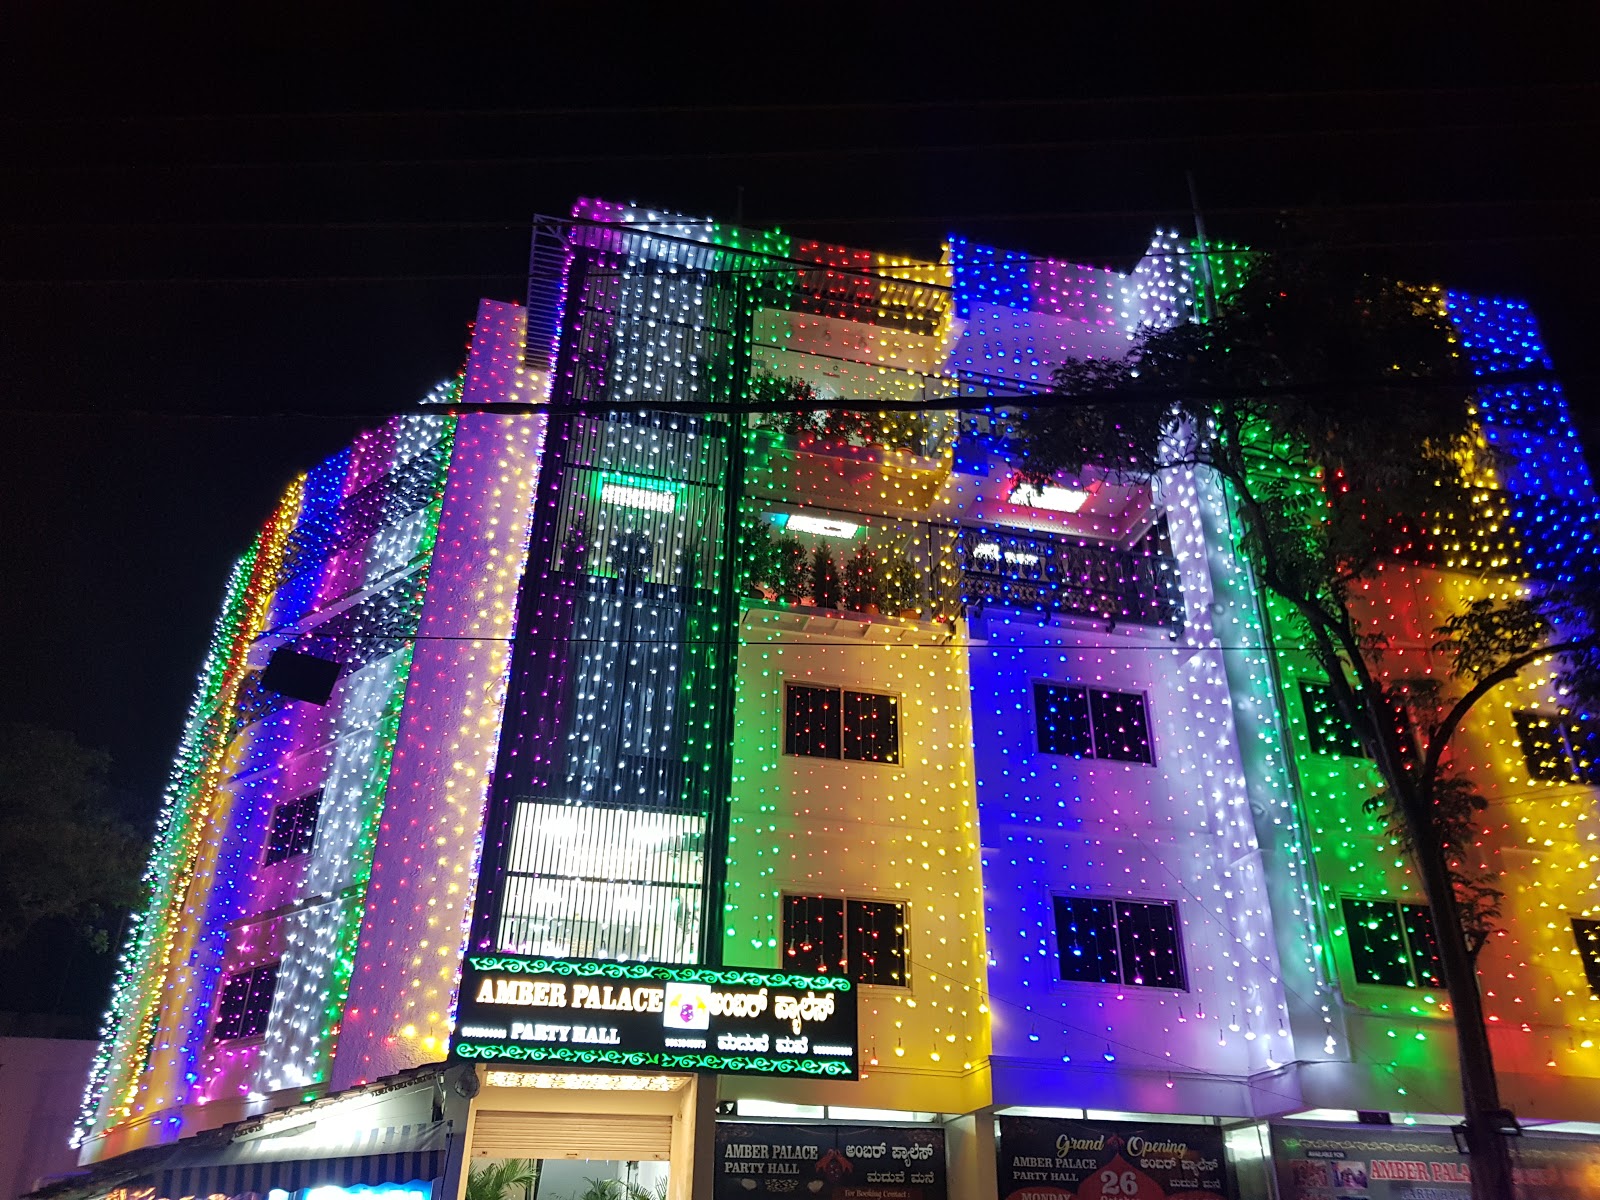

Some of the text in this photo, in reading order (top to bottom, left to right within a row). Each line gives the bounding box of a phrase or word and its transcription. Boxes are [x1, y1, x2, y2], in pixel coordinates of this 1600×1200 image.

[476, 978, 664, 1013] AMBER PALACE
[511, 1023, 571, 1043] PARTY
[572, 1026, 621, 1045] HALL
[724, 1143, 818, 1160] AMBER PALACE
[1055, 1134, 1187, 1159] Grand Opening
[724, 1162, 799, 1175] PARTY HALL
[1013, 1156, 1097, 1170] AMBER PALACE
[1370, 1159, 1471, 1184] AMBER PALA
[1013, 1171, 1079, 1182] PARTY HALL
[1100, 1170, 1138, 1196] 26
